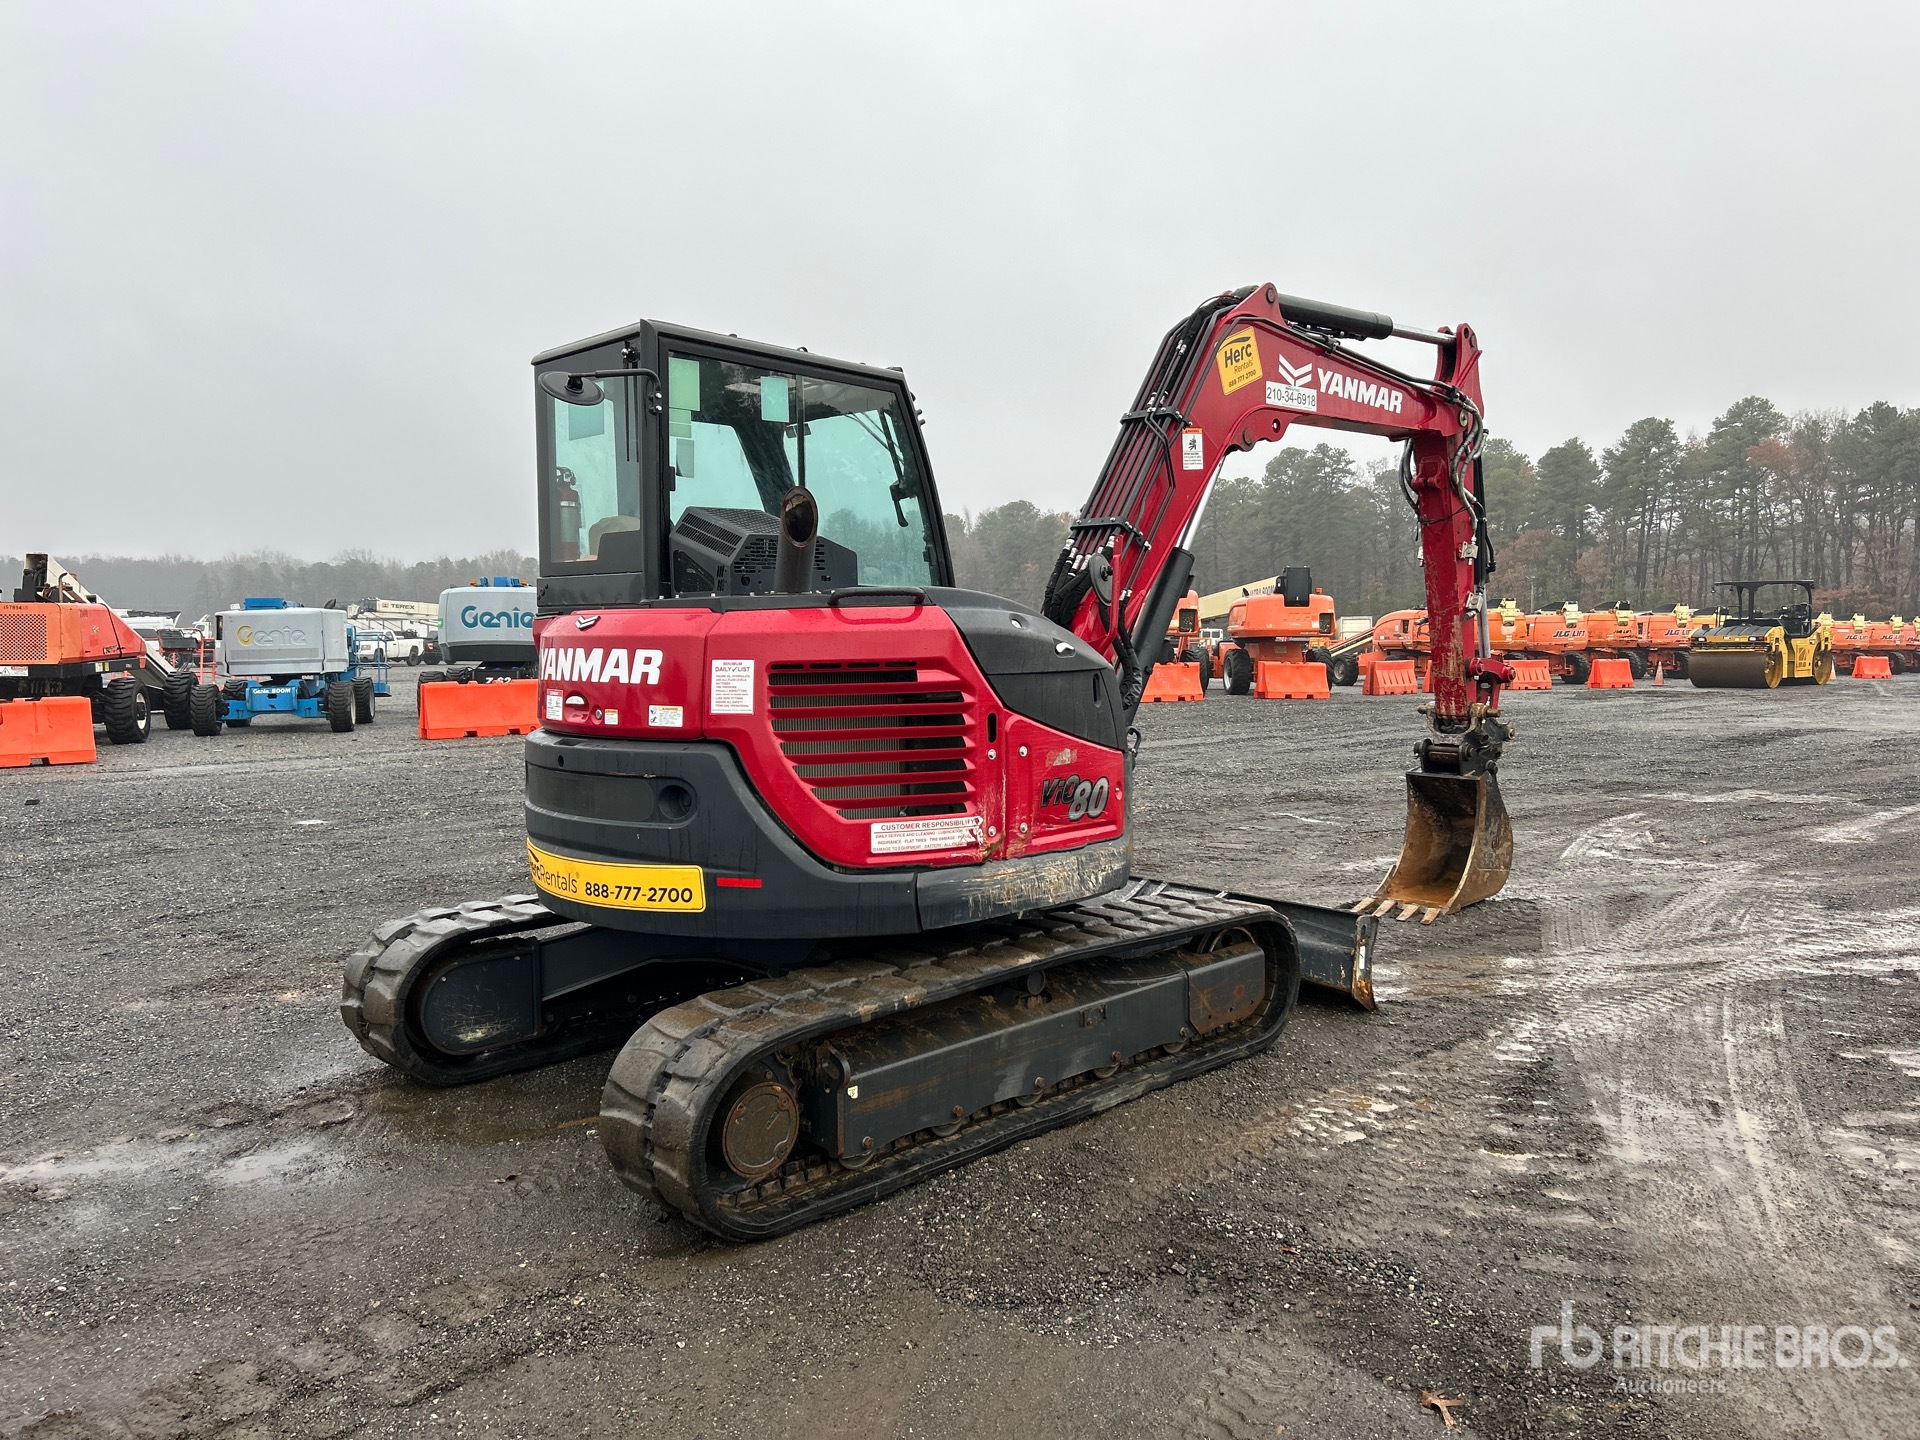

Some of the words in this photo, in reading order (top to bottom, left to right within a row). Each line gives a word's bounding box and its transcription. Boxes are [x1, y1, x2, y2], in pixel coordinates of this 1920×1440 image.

[1224, 343, 1252, 368] Herc
[1266, 386, 1316, 407] 210-34-6918
[1317, 367, 1403, 414] YANMAR
[461, 605, 535, 629] Genie
[237, 625, 307, 647] Genie
[541, 648, 663, 685] YANMAR
[881, 823, 920, 831] CUSTOMER
[922, 818, 975, 829] RESPONSIBILITY
[585, 881, 693, 903] 888-777-2700
